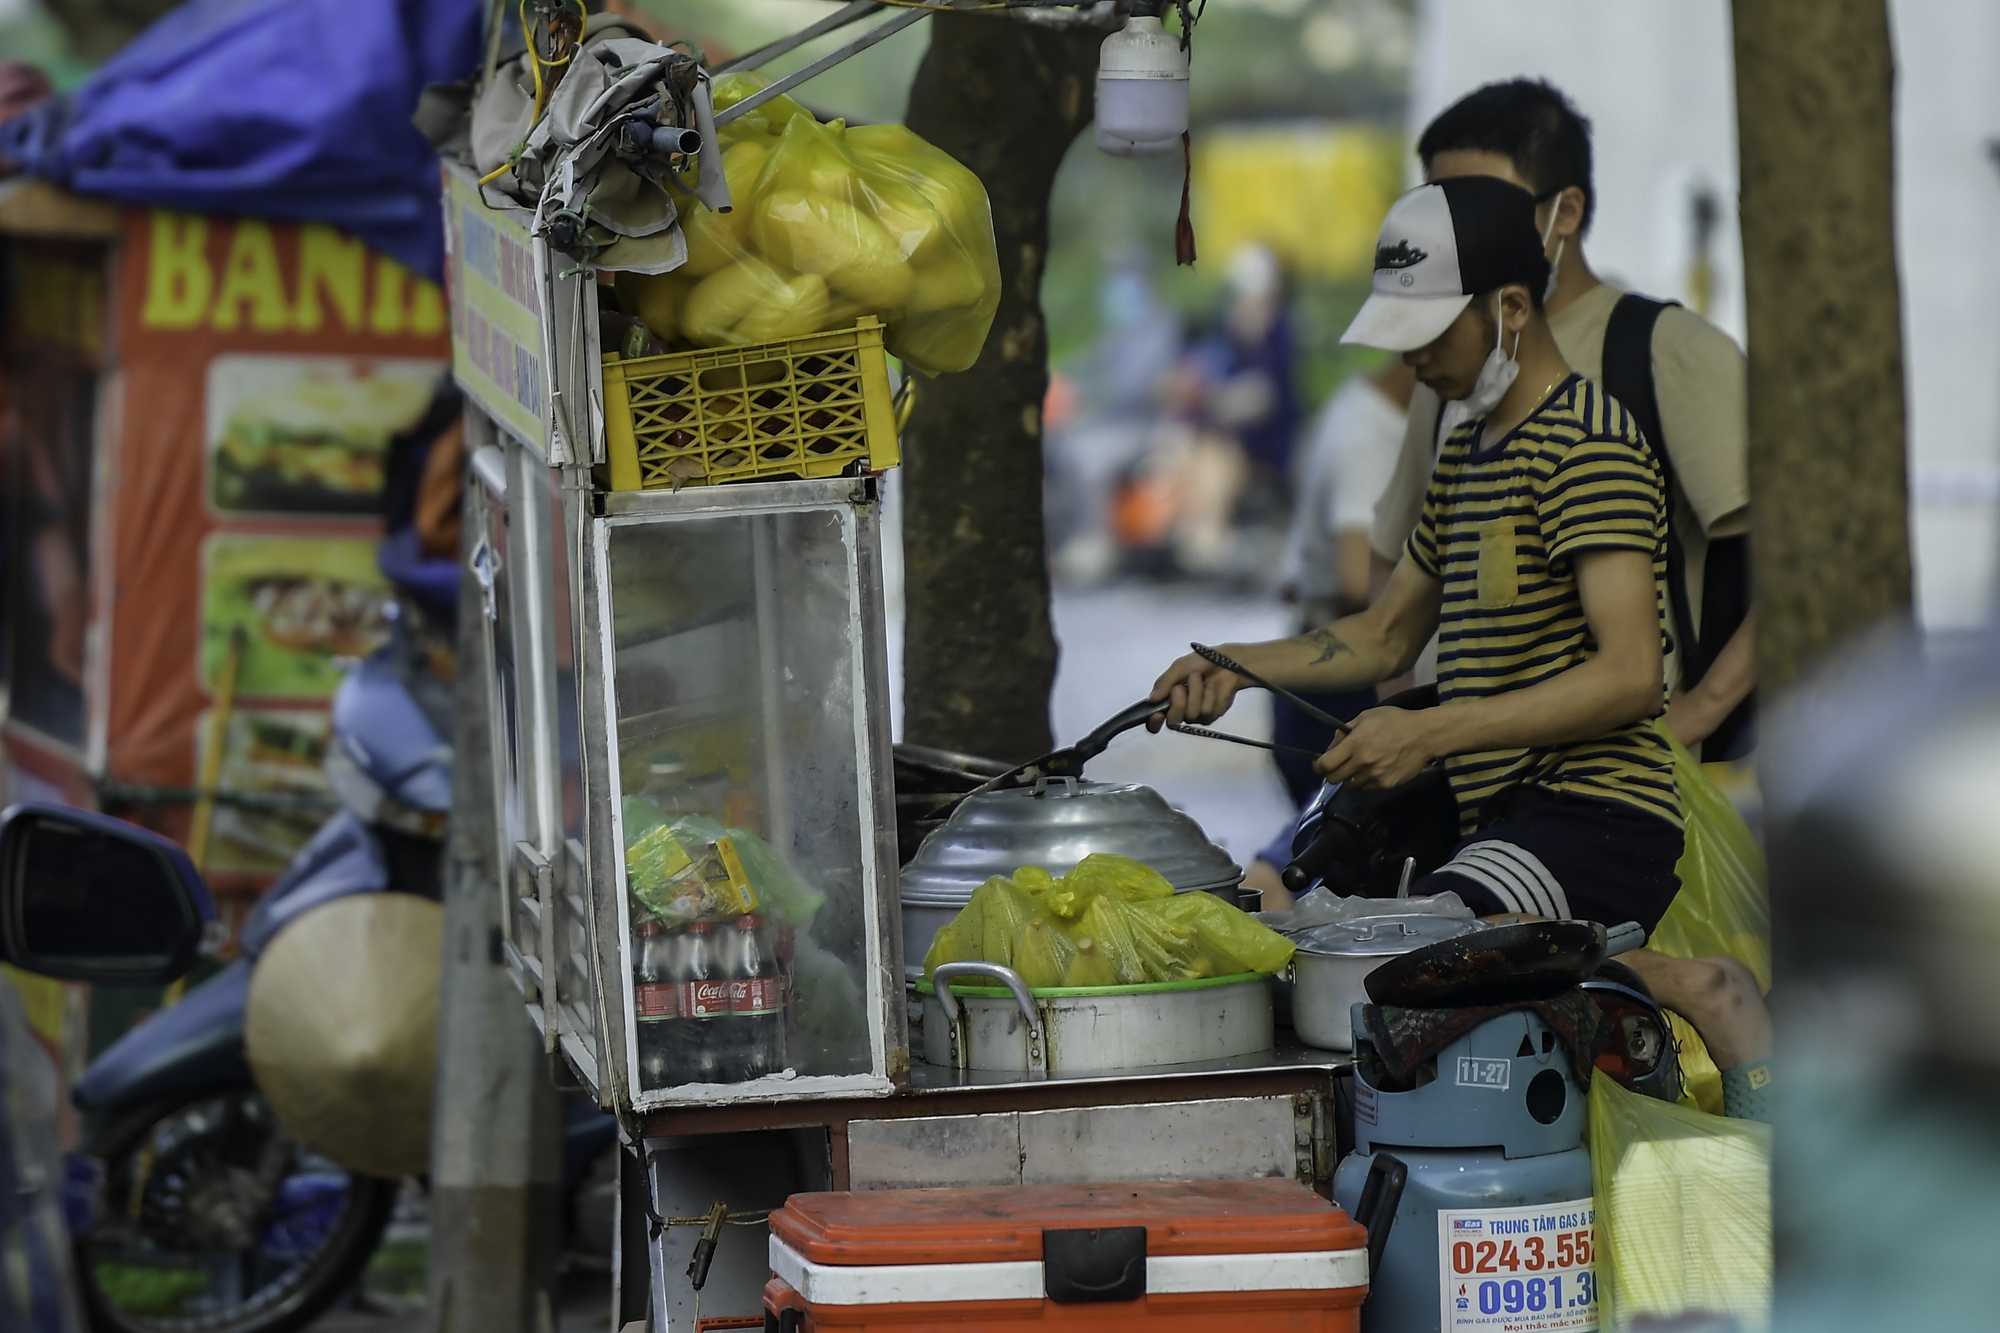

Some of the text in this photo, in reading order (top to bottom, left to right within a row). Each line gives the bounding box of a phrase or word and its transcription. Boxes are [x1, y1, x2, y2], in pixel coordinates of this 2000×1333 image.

[1461, 1061, 1506, 1084] 11-27
[1464, 1220, 1482, 1229] Gas
[1489, 1219, 1530, 1235] TRUNG
[1533, 1214, 1557, 1232] TÂM
[1559, 1213, 1578, 1229] GAS
[1580, 1211, 1587, 1226] &
[1475, 1317, 1491, 1325] GAS
[1514, 1315, 1530, 1323] MUA
[1503, 1324, 1523, 1332] Mọi
[1571, 1317, 1584, 1326] xin
